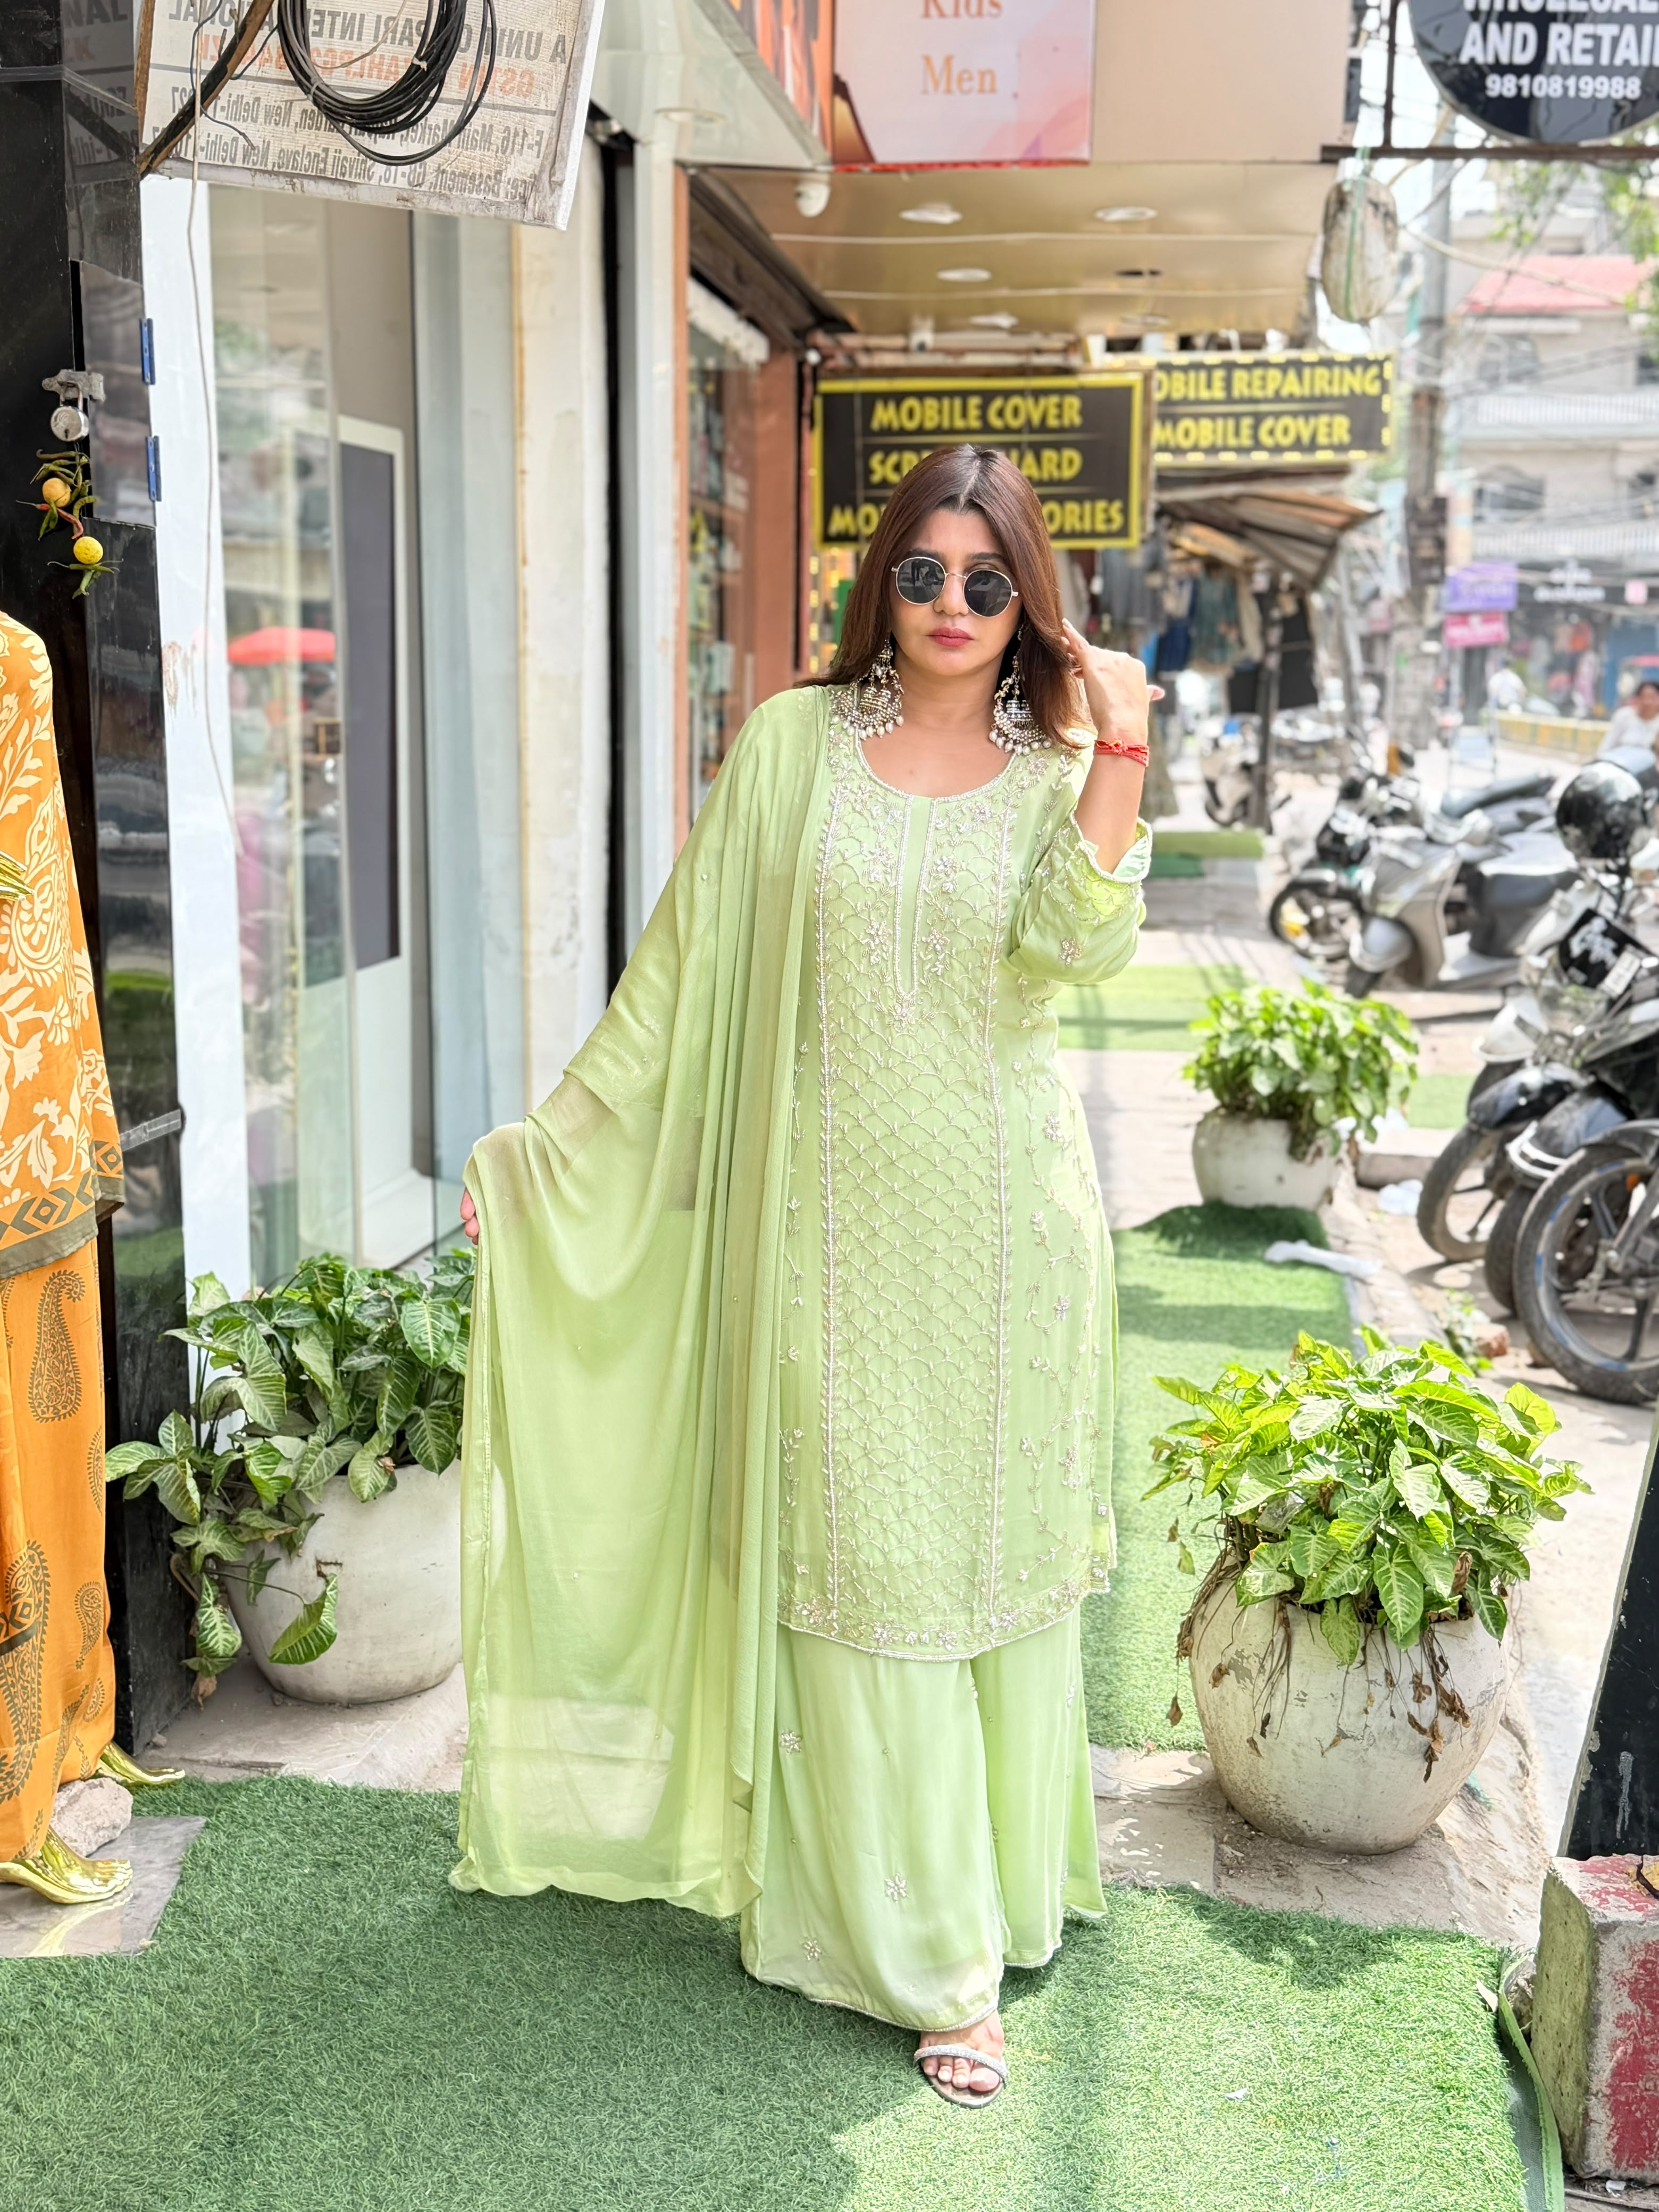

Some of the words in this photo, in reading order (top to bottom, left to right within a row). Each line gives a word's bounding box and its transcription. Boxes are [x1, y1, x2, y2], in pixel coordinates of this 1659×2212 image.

[1459, 21, 1538, 65] AND
[1546, 23, 1659, 66] RETAI
[920, 54, 998, 95] Men
[1485, 74, 1641, 99] 9810819988
[1154, 369, 1227, 401] OBILE
[1232, 364, 1382, 398] REPAIRING
[870, 395, 983, 431] MOBILE
[987, 393, 1083, 428] COVER
[1153, 416, 1254, 449] MOBILE
[1258, 413, 1352, 448] COVER
